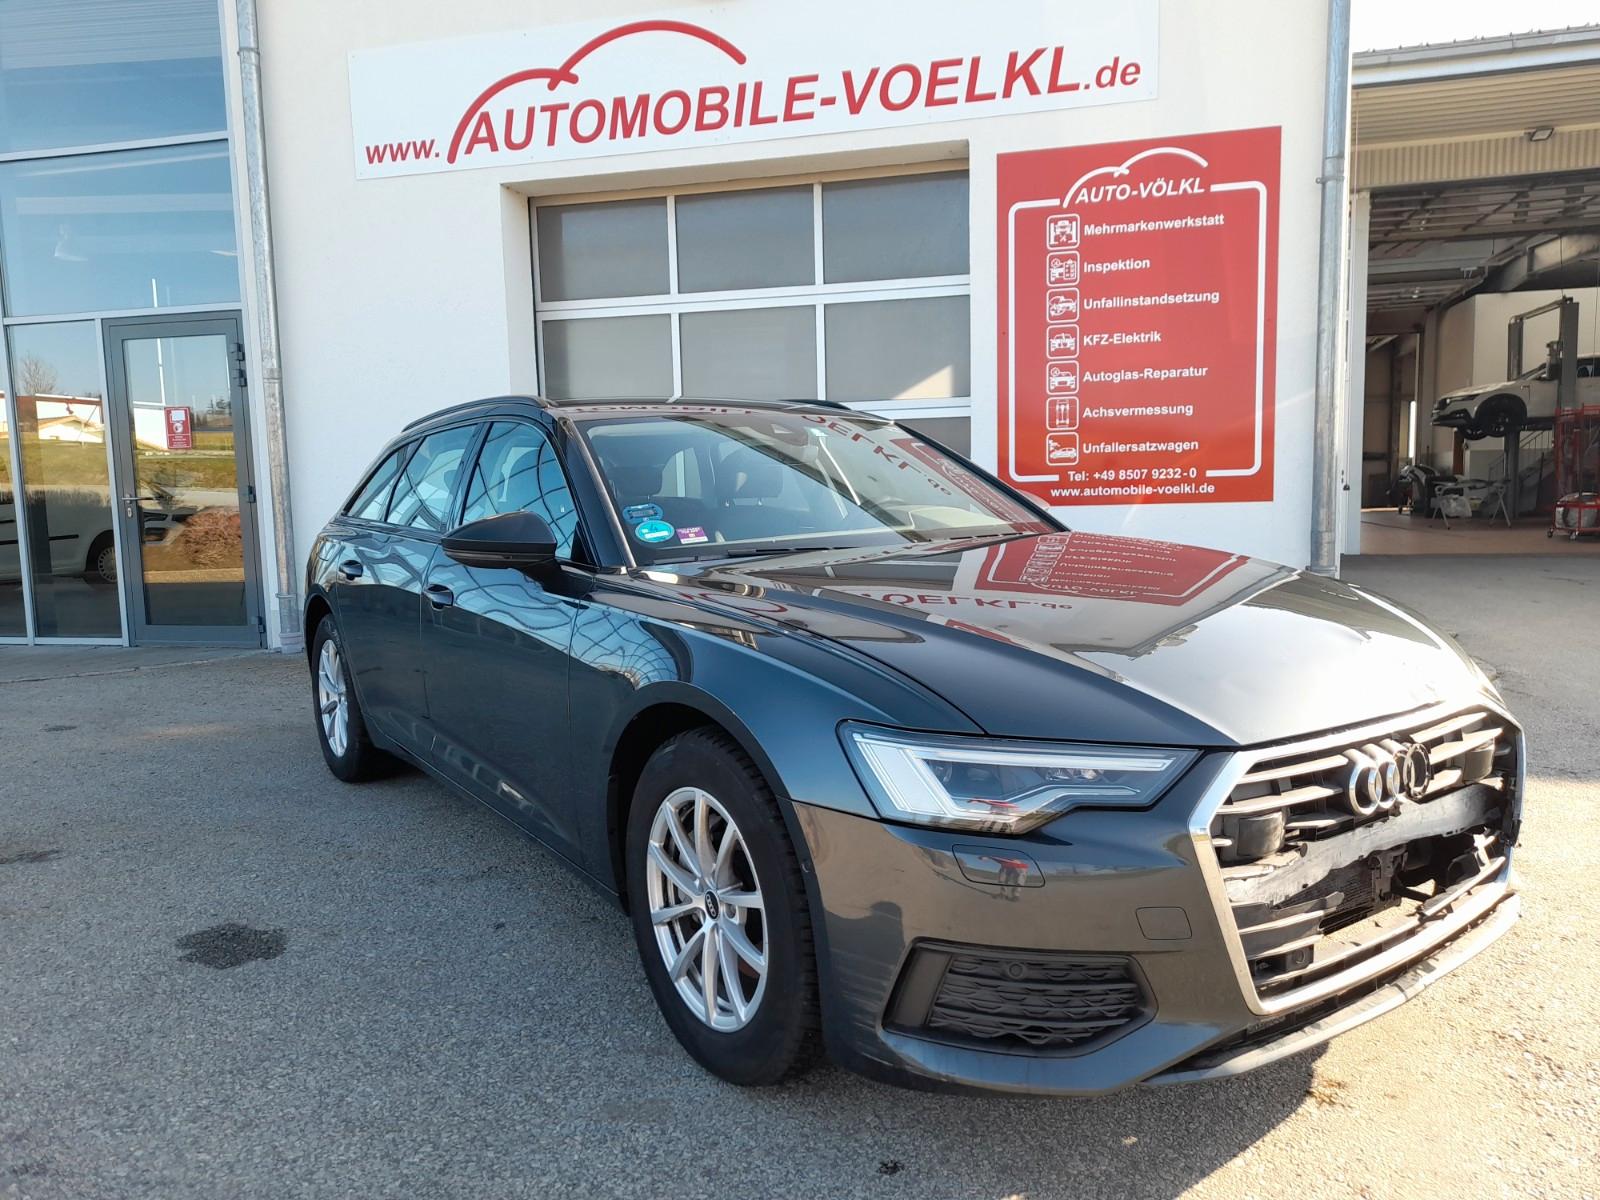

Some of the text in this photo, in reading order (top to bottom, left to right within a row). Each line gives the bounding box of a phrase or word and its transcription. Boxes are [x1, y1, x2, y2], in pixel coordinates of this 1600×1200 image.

[1075, 177, 1205, 204] AUTO-VÖLKL
[1083, 213, 1225, 236] Mehrmarkenwerkstatt
[1083, 258, 1151, 275] Inspektion
[1083, 291, 1220, 310] Unfallinstandsetzung
[1083, 330, 1162, 346] KFZ-Elektrik
[1082, 366, 1209, 384] Autoglas-Reparatur
[1082, 404, 1194, 418] Achsvermessung
[1082, 440, 1199, 454] Unfallersatzwagen
[1067, 470, 1090, 481] Tel:
[1093, 470, 1116, 481] +49
[1118, 468, 1148, 481] 8507
[1050, 482, 1215, 497] www.automobile-voelkl.de
